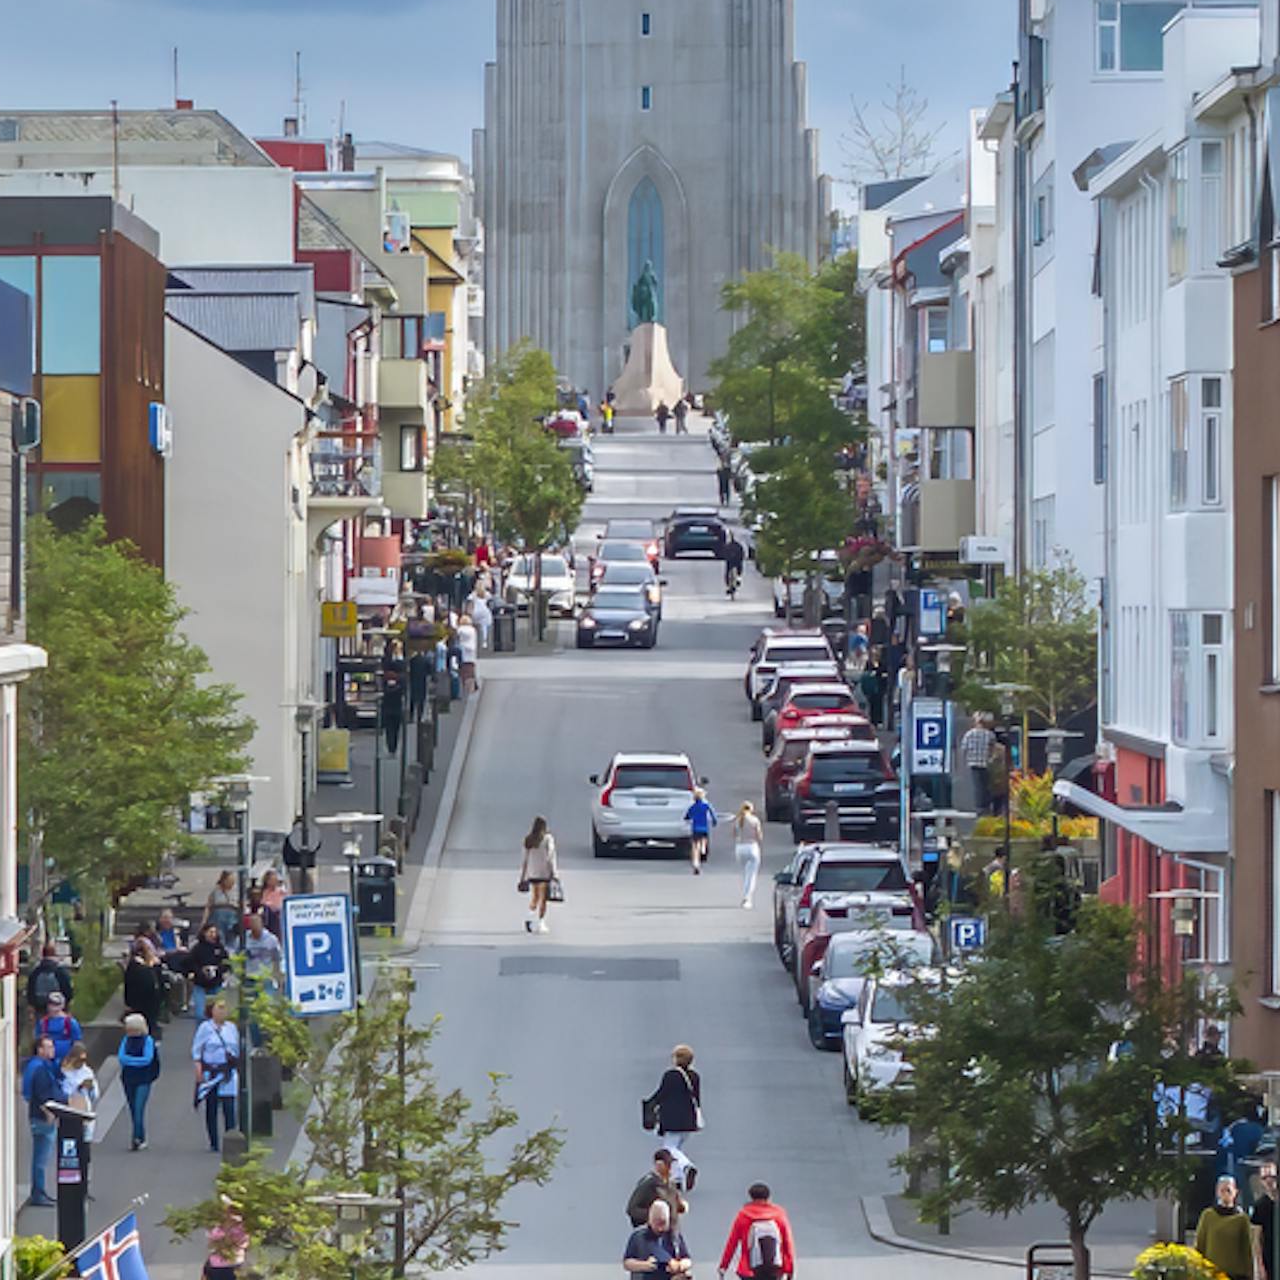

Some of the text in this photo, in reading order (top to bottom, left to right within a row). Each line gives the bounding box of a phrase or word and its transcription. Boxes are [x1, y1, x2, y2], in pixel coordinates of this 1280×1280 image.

[922, 723, 940, 745] P
[960, 924, 976, 946] P
[305, 931, 331, 968] P
